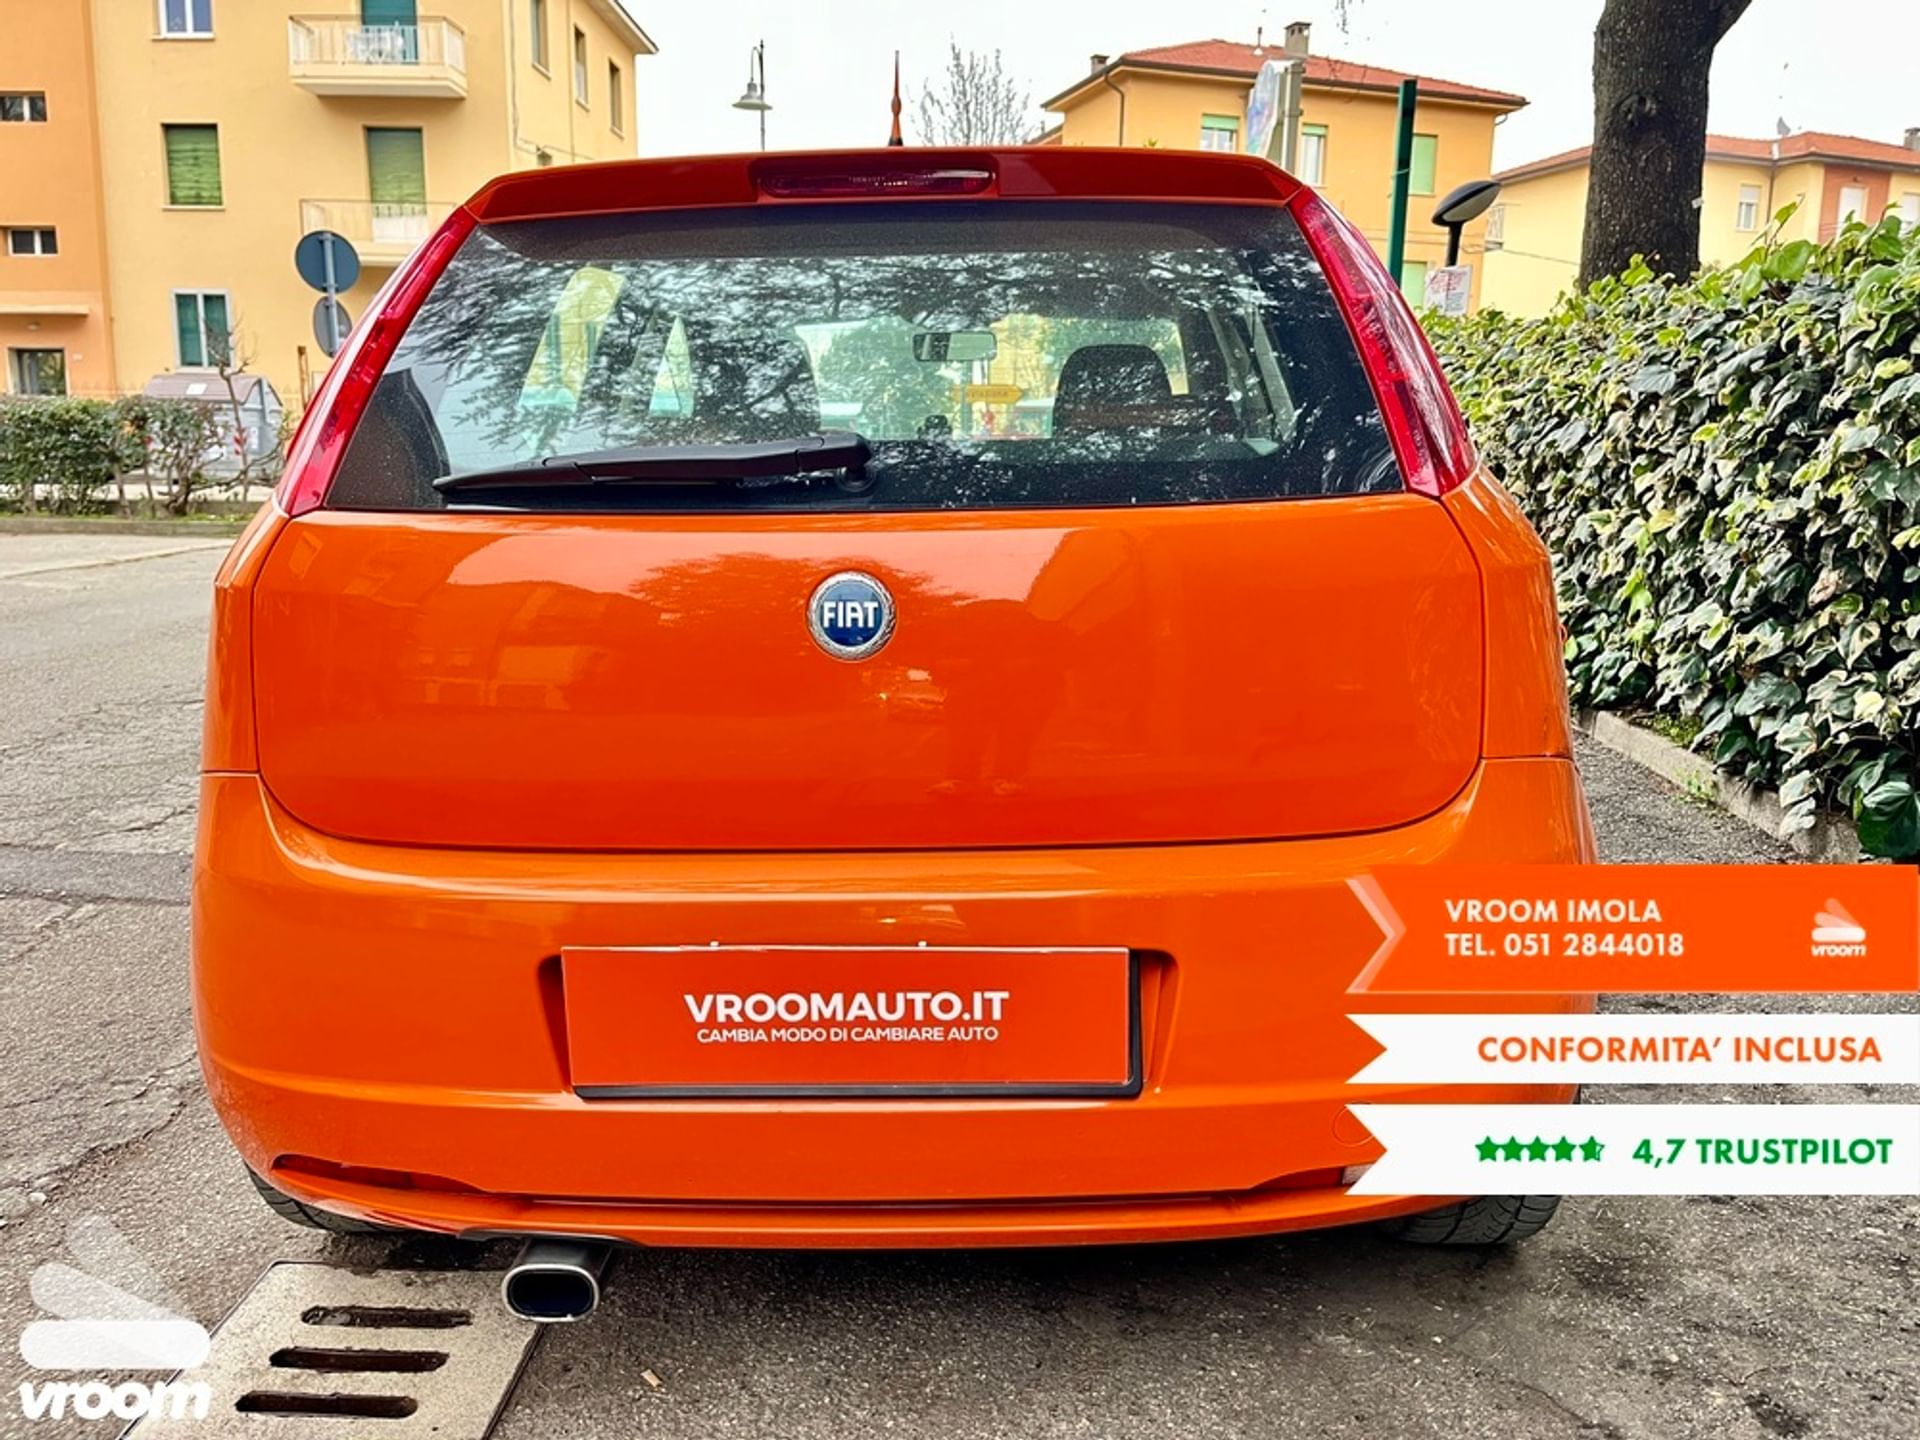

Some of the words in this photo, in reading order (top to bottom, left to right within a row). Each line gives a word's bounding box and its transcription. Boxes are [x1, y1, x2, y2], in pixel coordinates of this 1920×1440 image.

[823, 601, 879, 628] FIAT
[684, 991, 1010, 1023] VROOMAUTO.IT
[697, 1028, 768, 1043] CAMBIA
[771, 1027, 827, 1042] MODO
[830, 1027, 848, 1042] DI
[850, 1027, 945, 1042] CAMBIARE
[948, 1026, 998, 1041] AUTO
